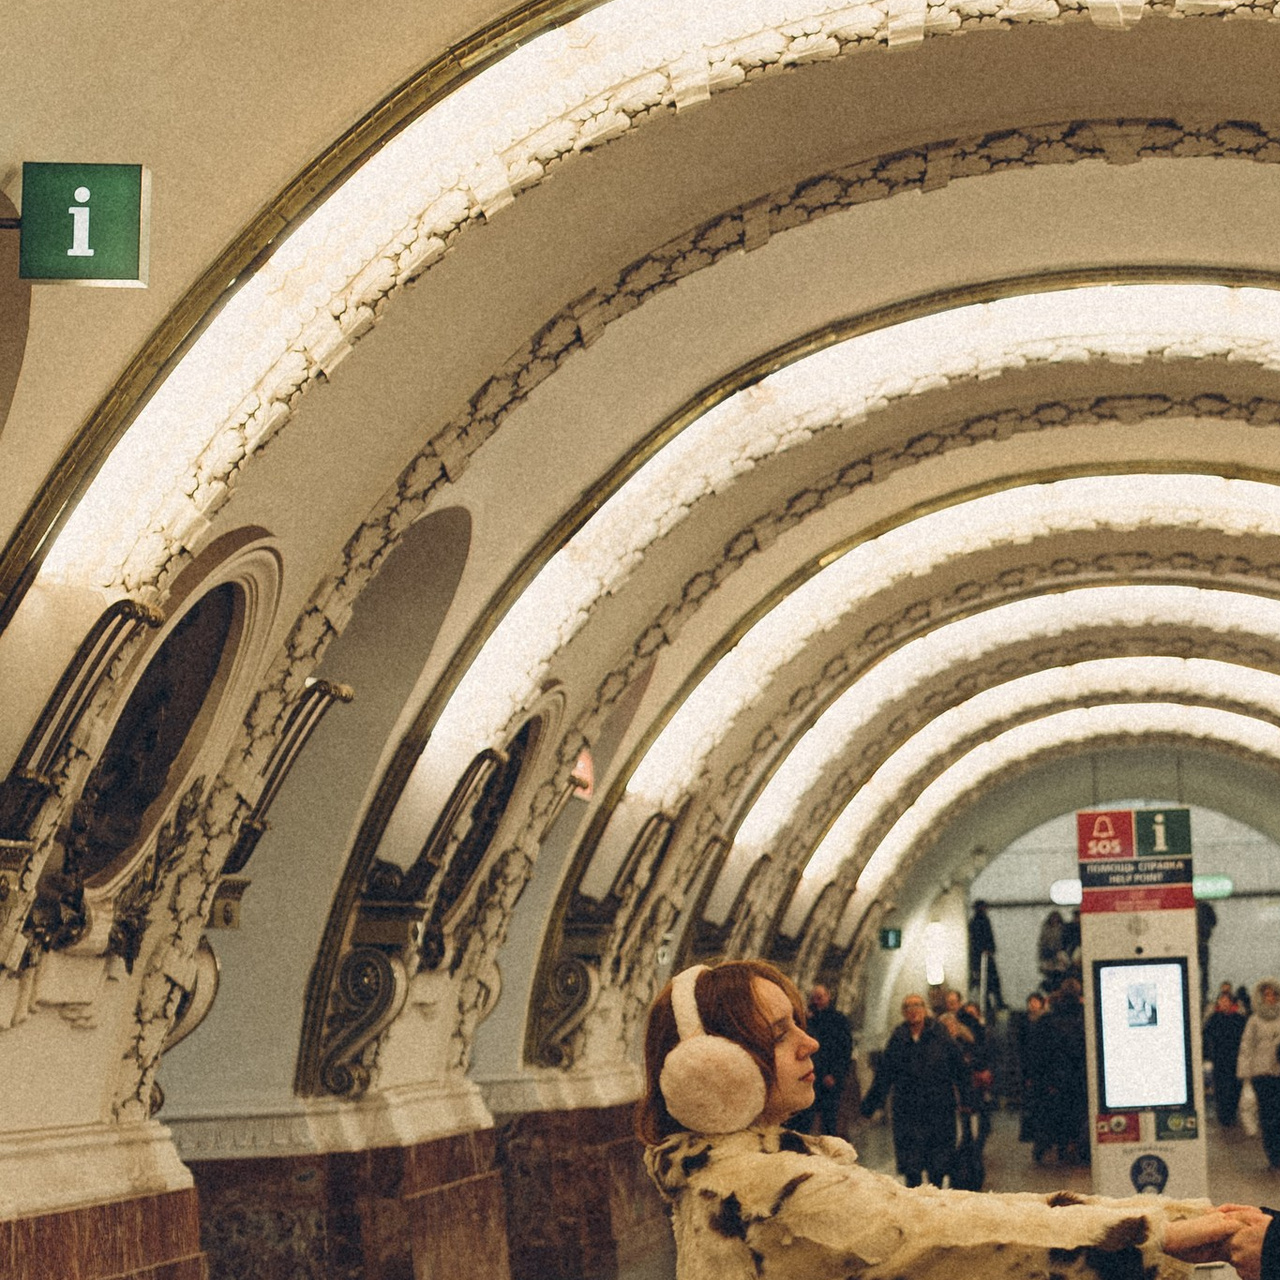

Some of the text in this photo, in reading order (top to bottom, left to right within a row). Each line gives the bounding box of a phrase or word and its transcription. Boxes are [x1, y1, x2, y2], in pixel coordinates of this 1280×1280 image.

[67, 186, 94, 257] i
[1152, 813, 1168, 852] i
[1087, 838, 1122, 855] SOS
[1086, 860, 1185, 874] ПОМОЩЬ СПРАВКА
[1108, 872, 1164, 884] HELP POINT
